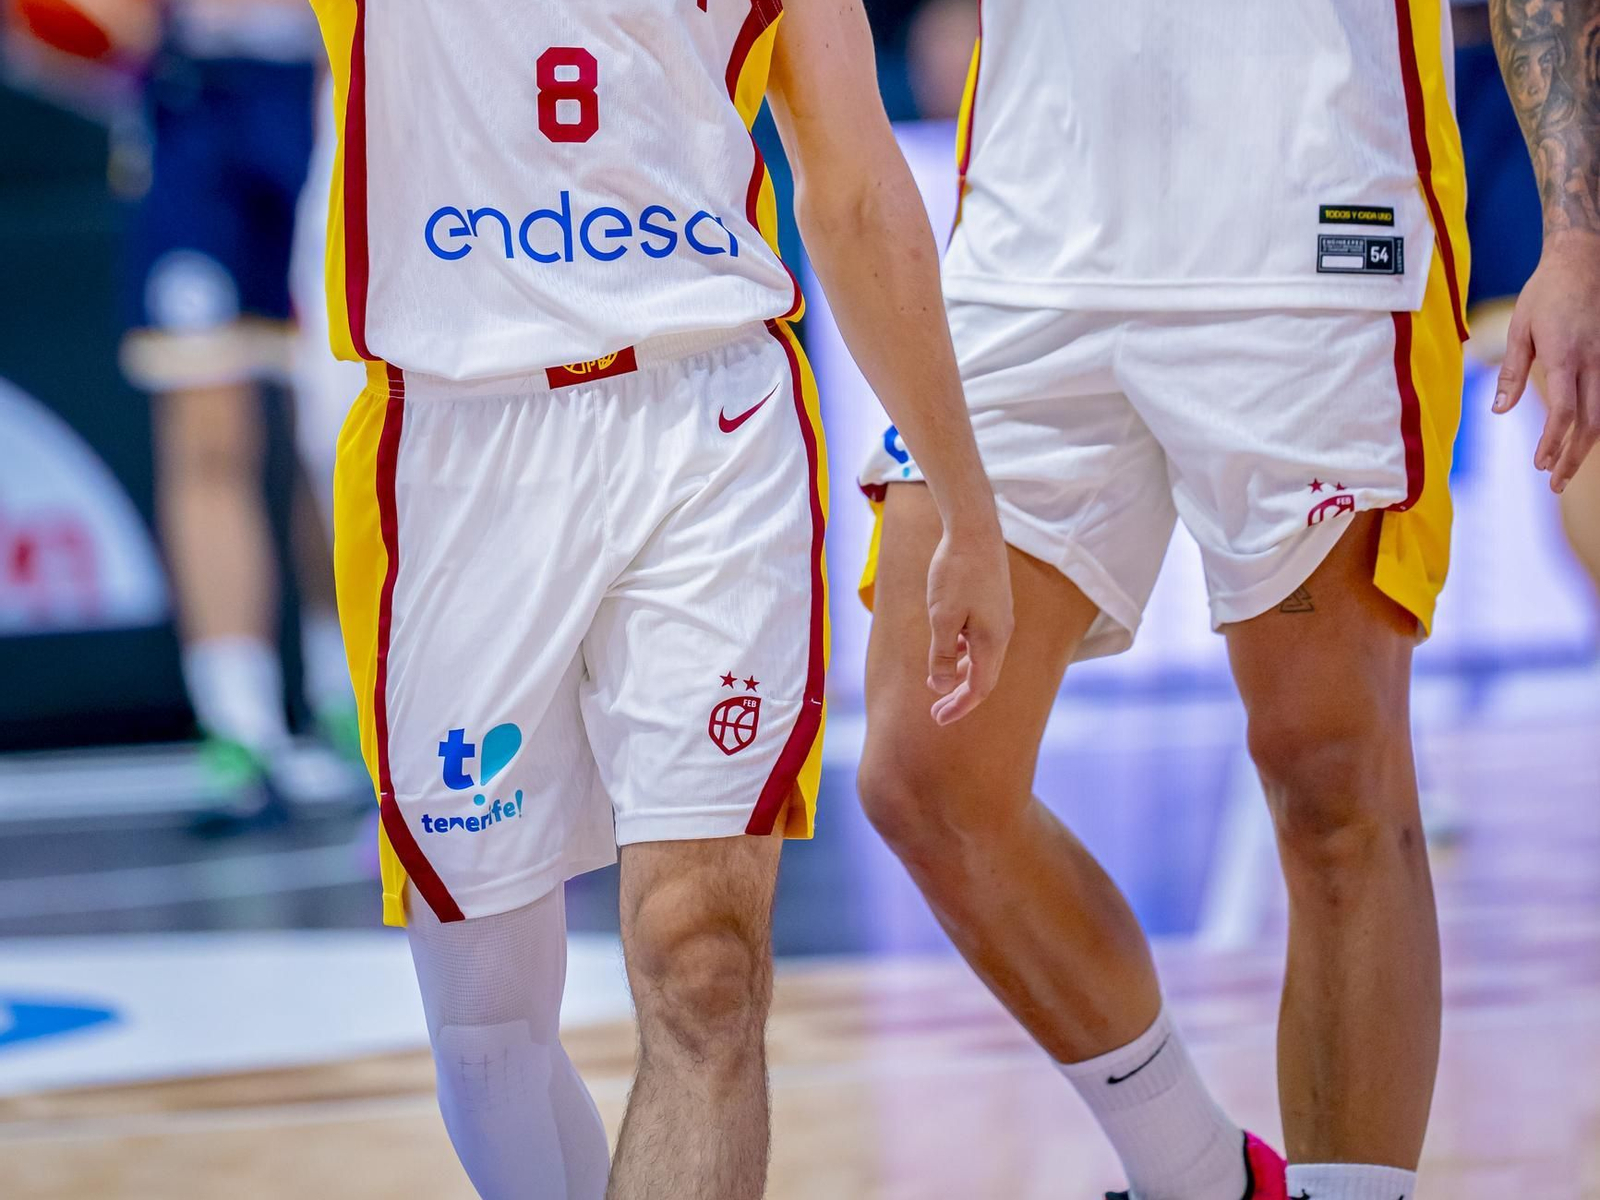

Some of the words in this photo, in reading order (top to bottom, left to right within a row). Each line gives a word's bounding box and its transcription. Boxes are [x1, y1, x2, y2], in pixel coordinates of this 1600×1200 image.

[536, 47, 599, 143] 8
[1325, 209, 1351, 219] TODOS
[424, 190, 739, 265] endesa
[1370, 246, 1389, 263] 54
[743, 698, 757, 708] FEB
